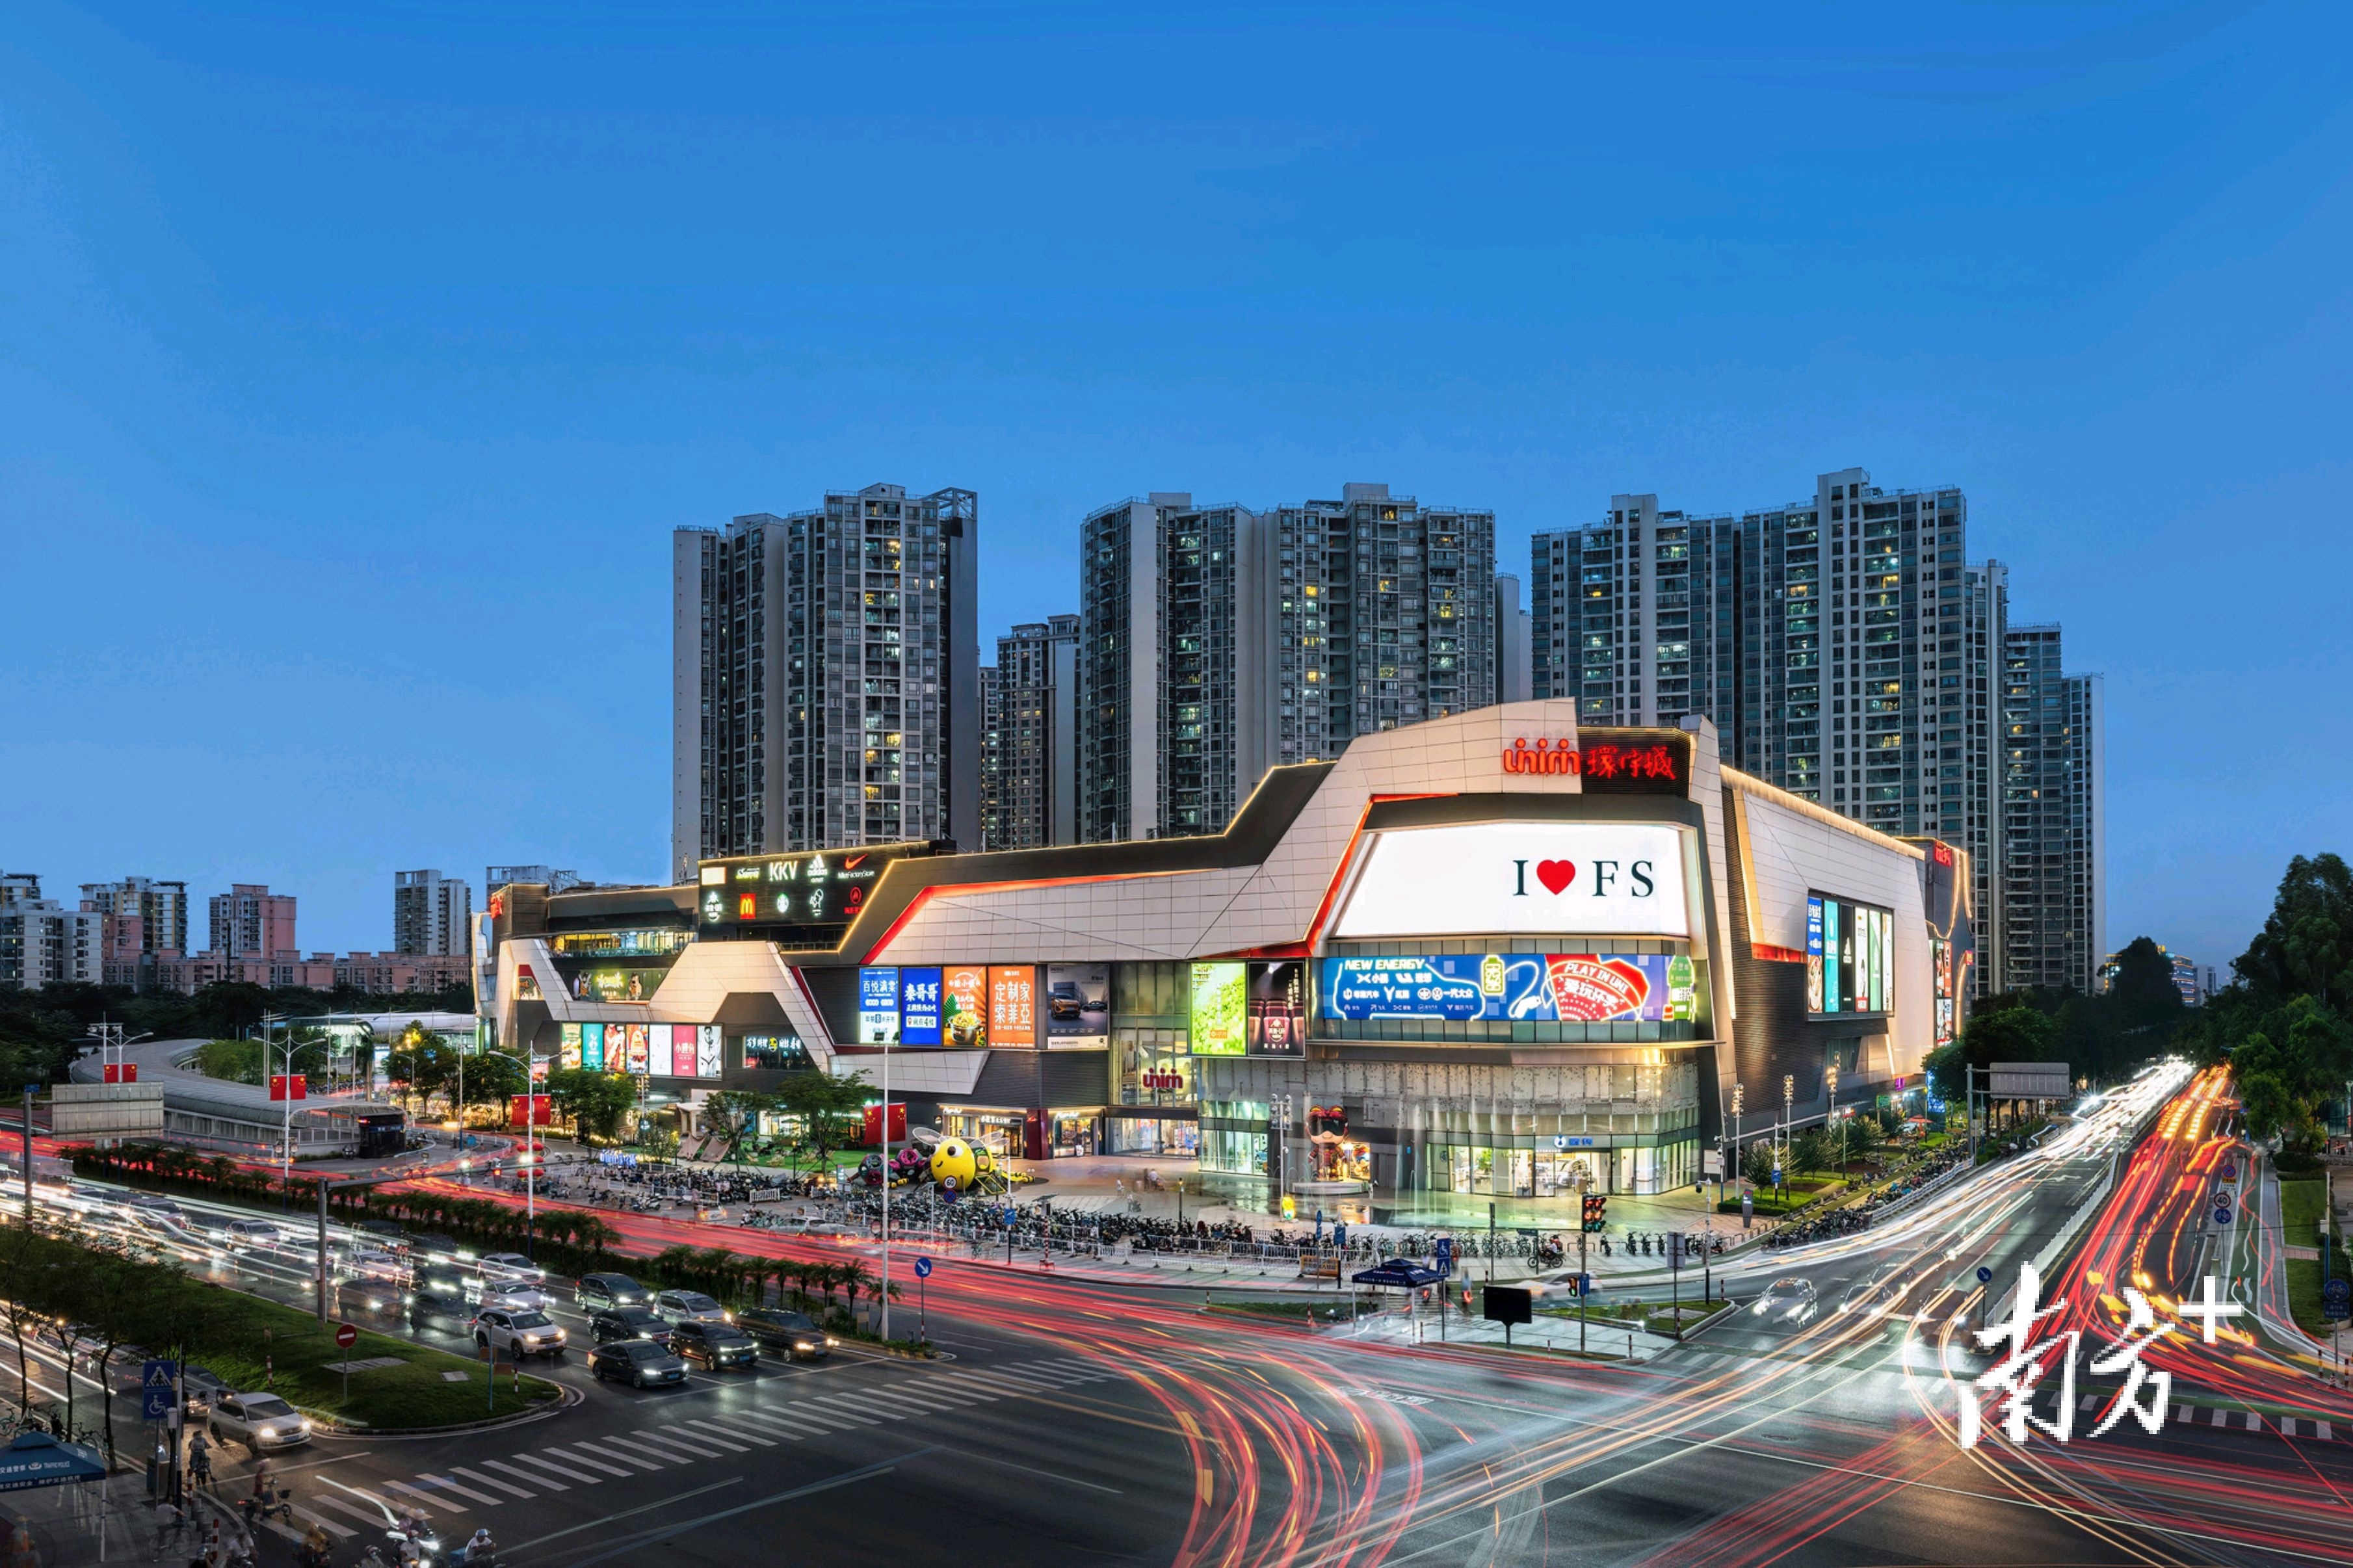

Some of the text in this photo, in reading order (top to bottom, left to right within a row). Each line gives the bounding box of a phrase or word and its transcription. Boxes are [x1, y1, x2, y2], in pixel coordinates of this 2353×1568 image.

[769, 860, 798, 882] KKV
[1512, 859, 1529, 896] I
[1344, 959, 1425, 970] NEW ENERGY
[1564, 962, 1631, 995] PLAY IN UNI
[995, 980, 1031, 1002] 定制家
